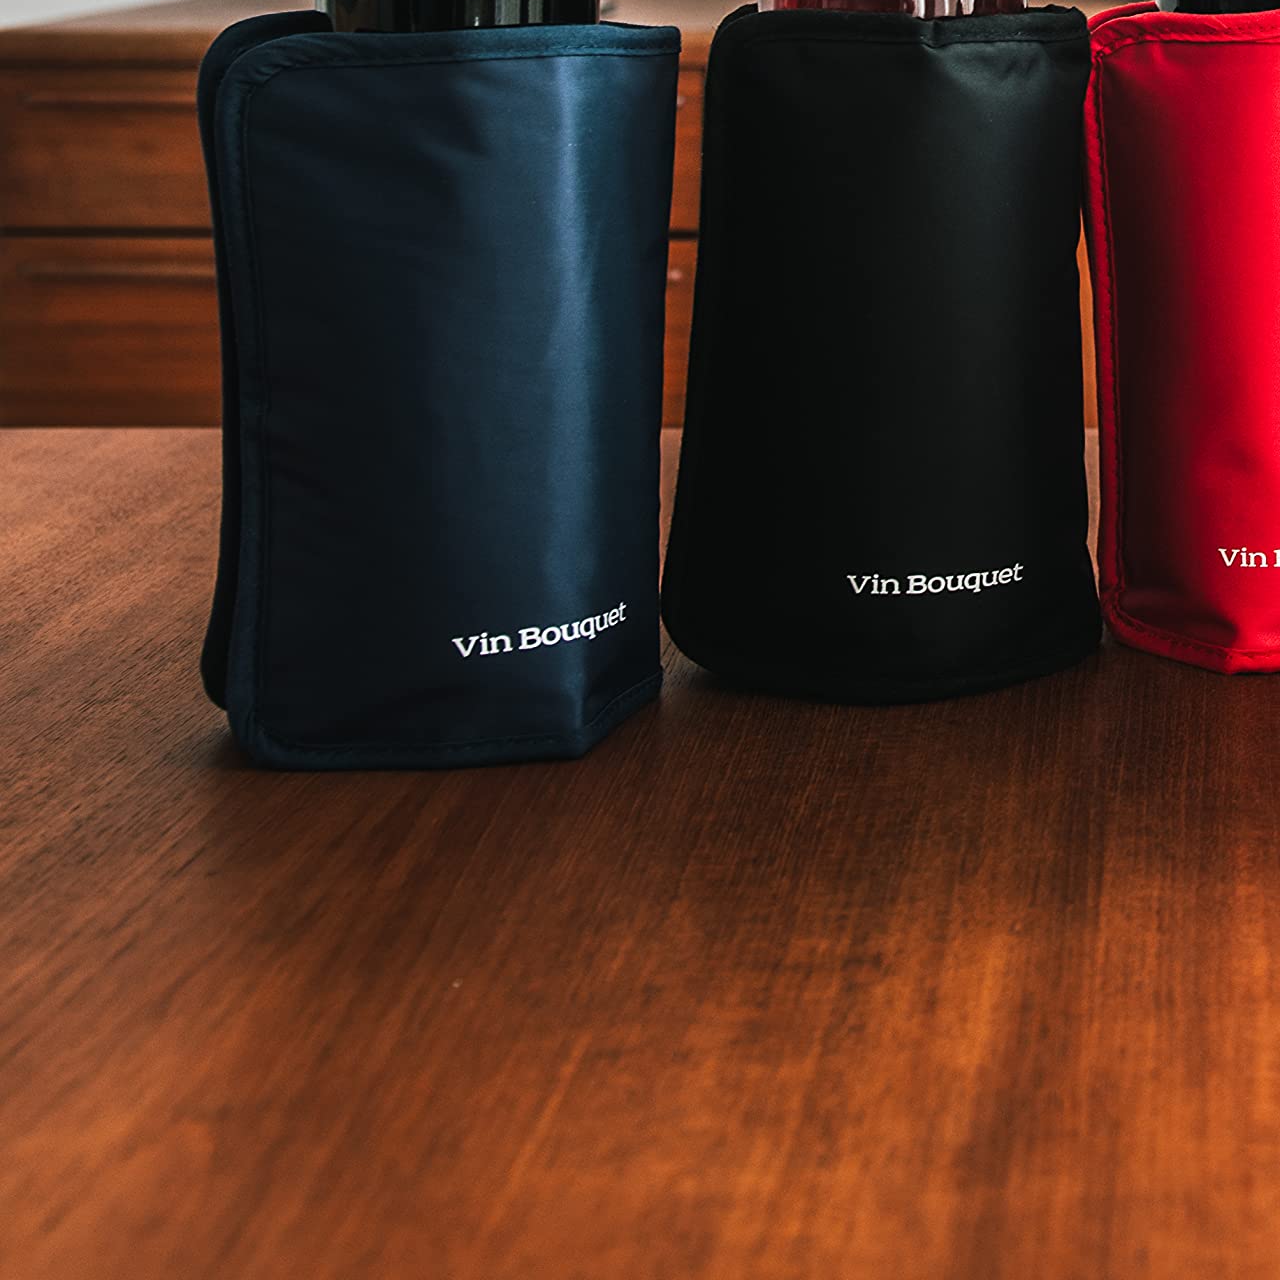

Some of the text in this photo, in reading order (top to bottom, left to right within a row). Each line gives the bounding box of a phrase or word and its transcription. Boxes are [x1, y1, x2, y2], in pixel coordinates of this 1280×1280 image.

[1218, 547, 1268, 568] Vin
[846, 562, 1024, 595] Vin Bouquet
[452, 601, 627, 658] Vin Bouquet
